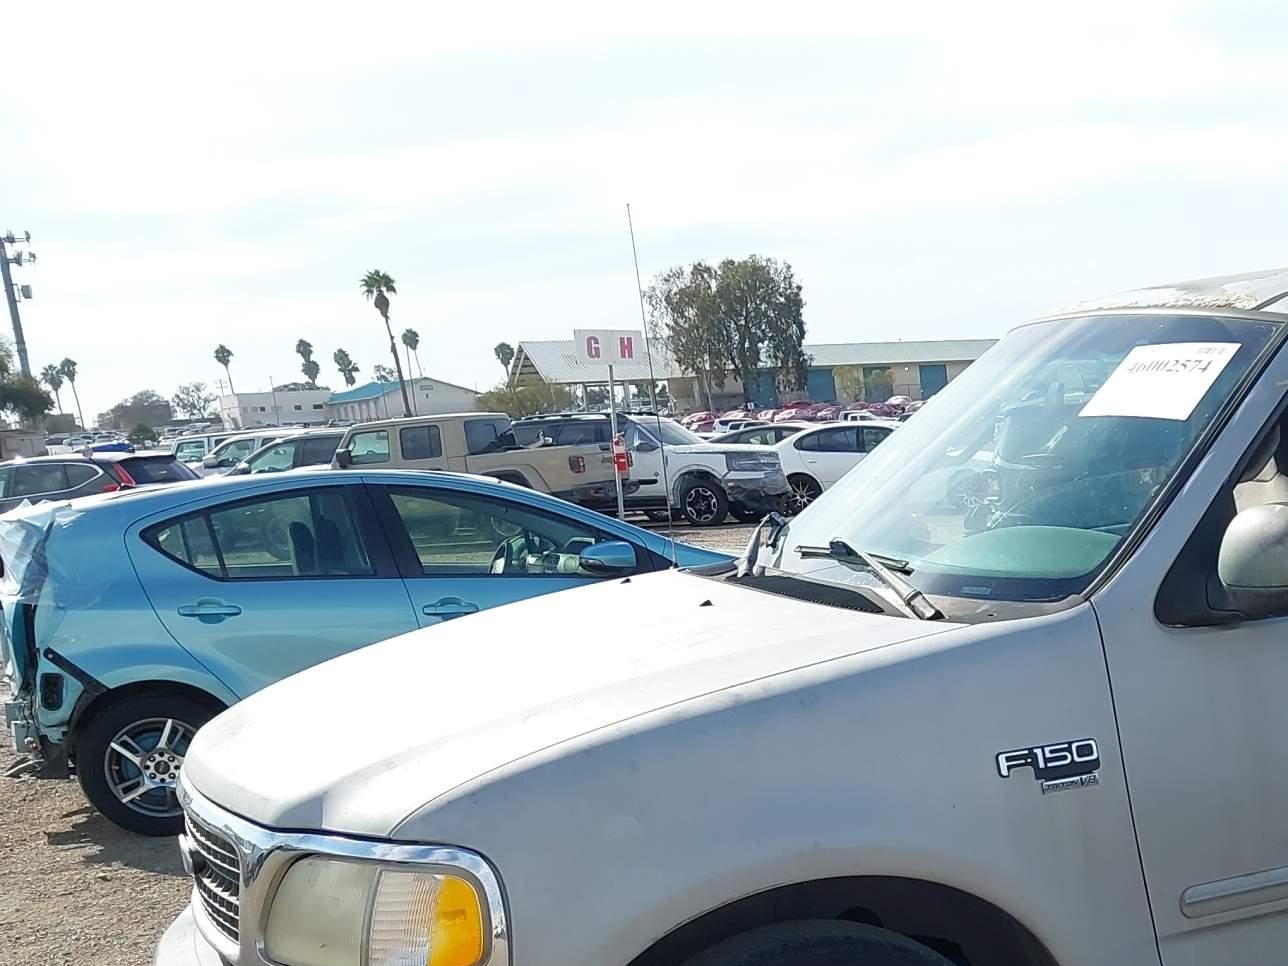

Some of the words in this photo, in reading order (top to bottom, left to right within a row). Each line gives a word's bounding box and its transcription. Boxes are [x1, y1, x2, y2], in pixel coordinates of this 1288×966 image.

[587, 336, 600, 359] G
[620, 336, 633, 359] H
[1127, 359, 1213, 373] 46002574
[996, 737, 1099, 777] F-150
[1080, 774, 1098, 786] V8
